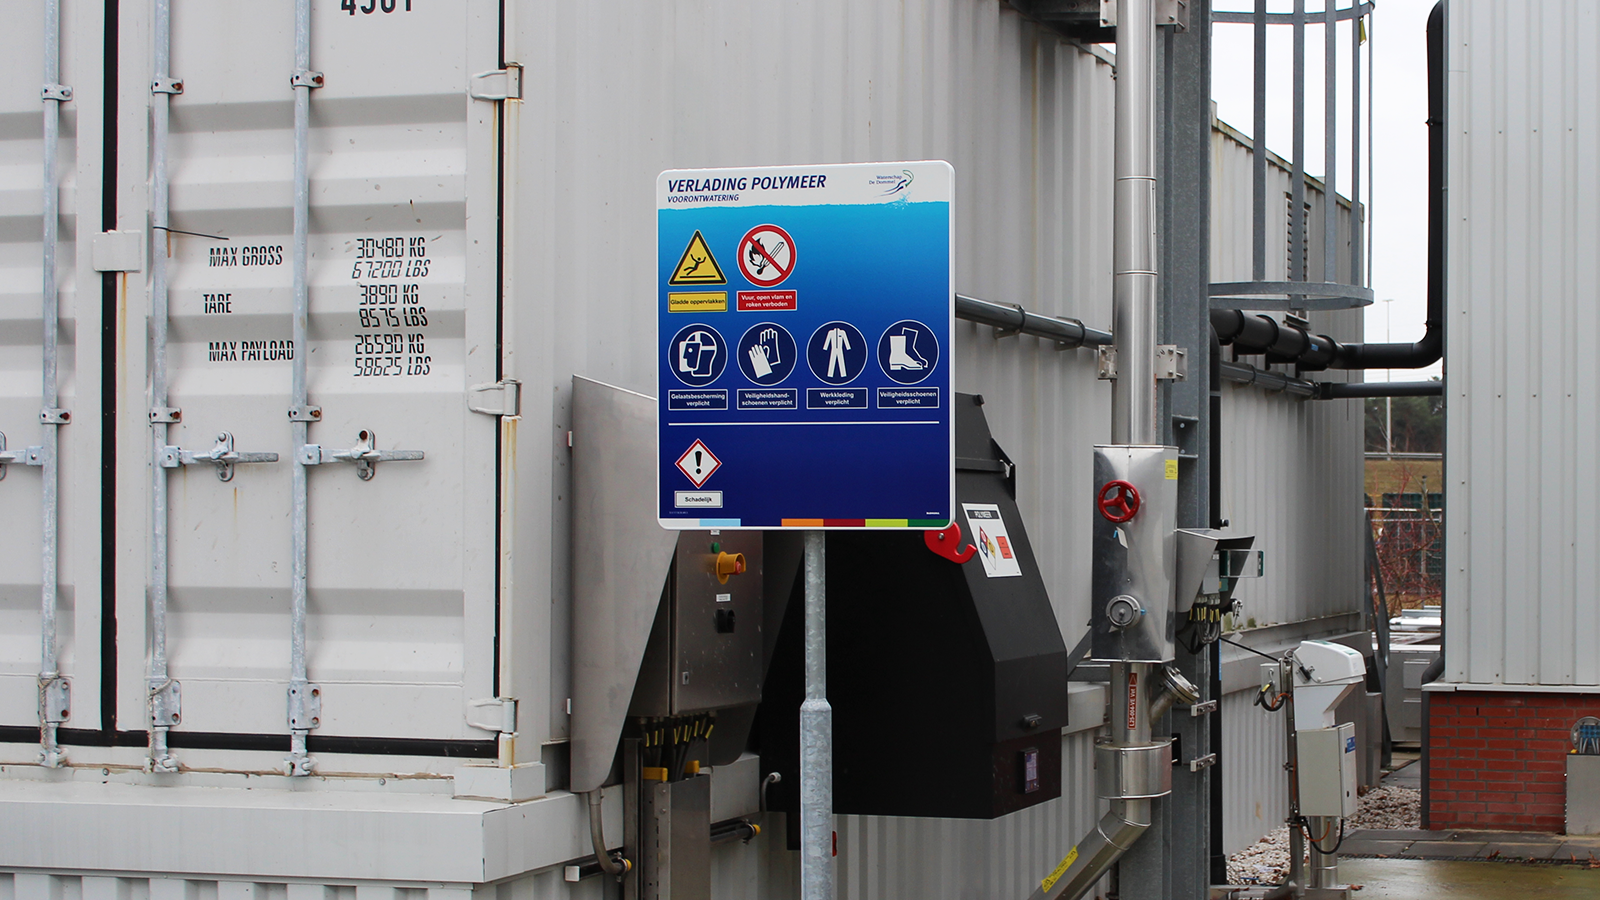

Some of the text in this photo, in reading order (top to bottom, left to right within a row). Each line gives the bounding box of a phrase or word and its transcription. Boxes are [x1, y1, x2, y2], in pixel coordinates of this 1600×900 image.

[668, 174, 827, 193] VERLADING POLYMEER
[667, 194, 740, 203] VOORONTWATERING
[209, 237, 426, 267] MAX GROSS 30480 KG
[351, 259, 431, 279] 67200 LBS
[203, 284, 419, 314] TARE 3890 KG
[359, 307, 428, 328] 8575 LBS
[208, 333, 425, 362] MAX PAYLOAD 26590 KG
[353, 356, 431, 377] 58625 LBS
[745, 392, 790, 400] Veiligheidshand-
